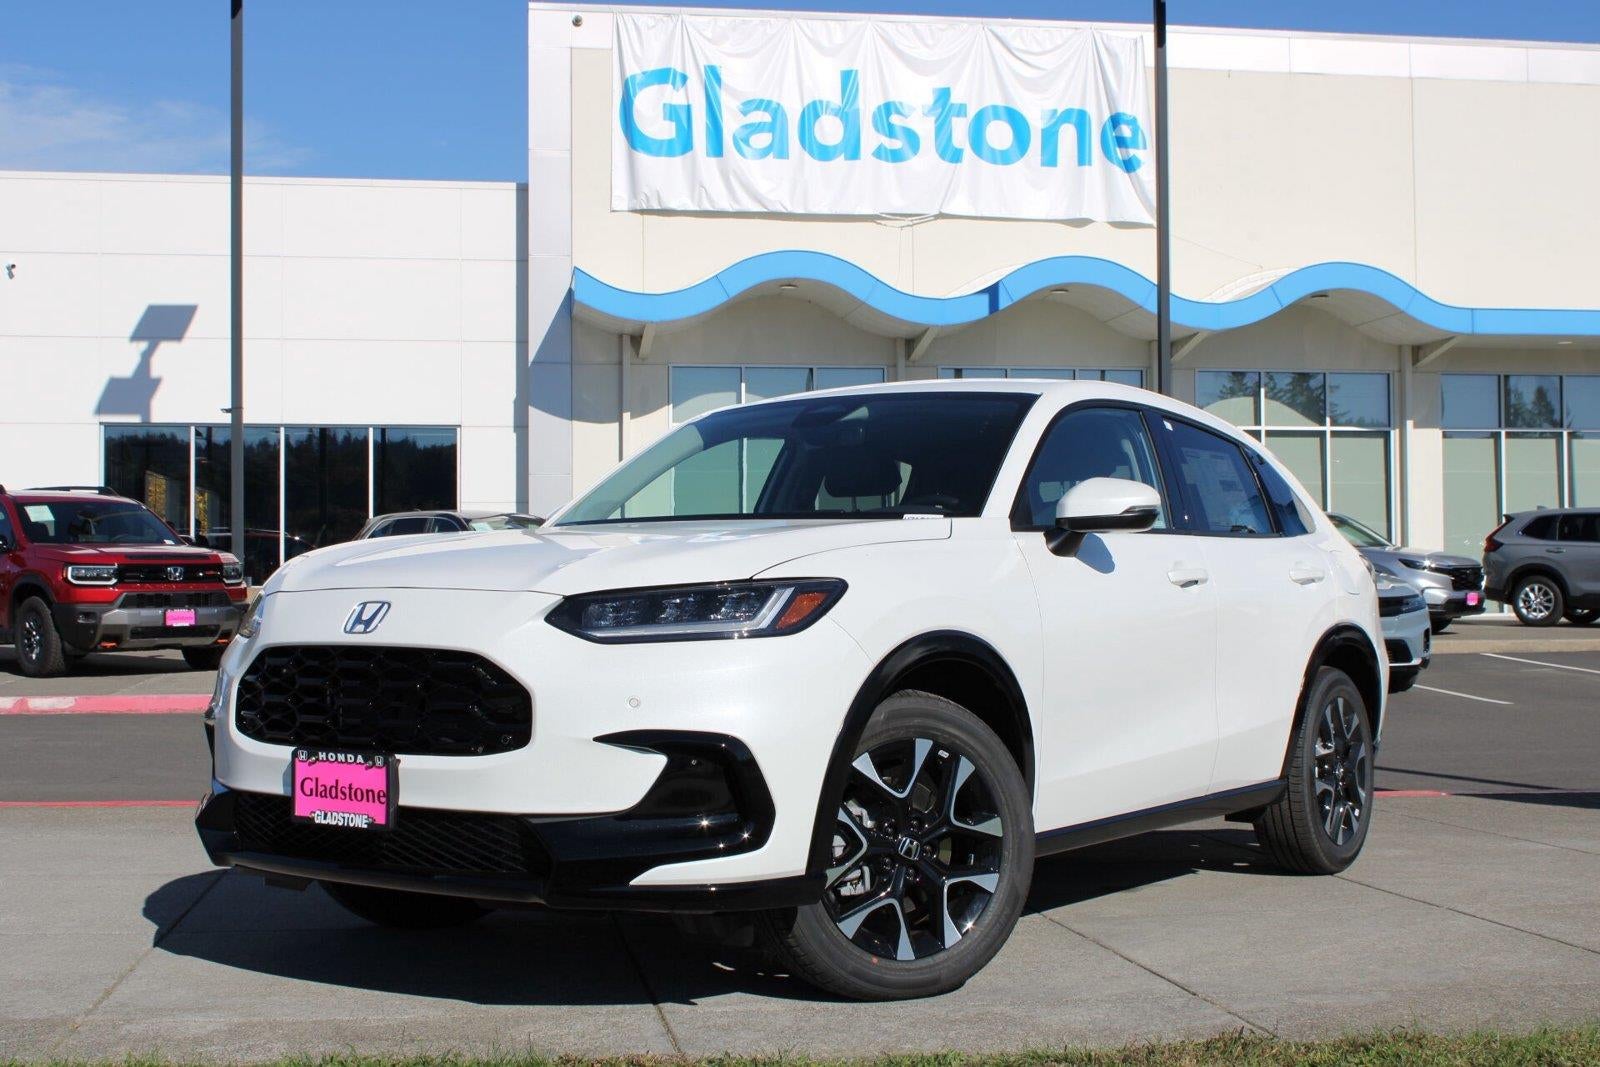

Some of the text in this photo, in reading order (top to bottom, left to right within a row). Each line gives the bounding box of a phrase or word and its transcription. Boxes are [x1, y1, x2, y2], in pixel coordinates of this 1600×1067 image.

[619, 64, 1148, 174] Gladstone
[318, 751, 365, 764] HONDA
[300, 776, 387, 805] Gladstone
[314, 810, 368, 828] GLADSTONE
